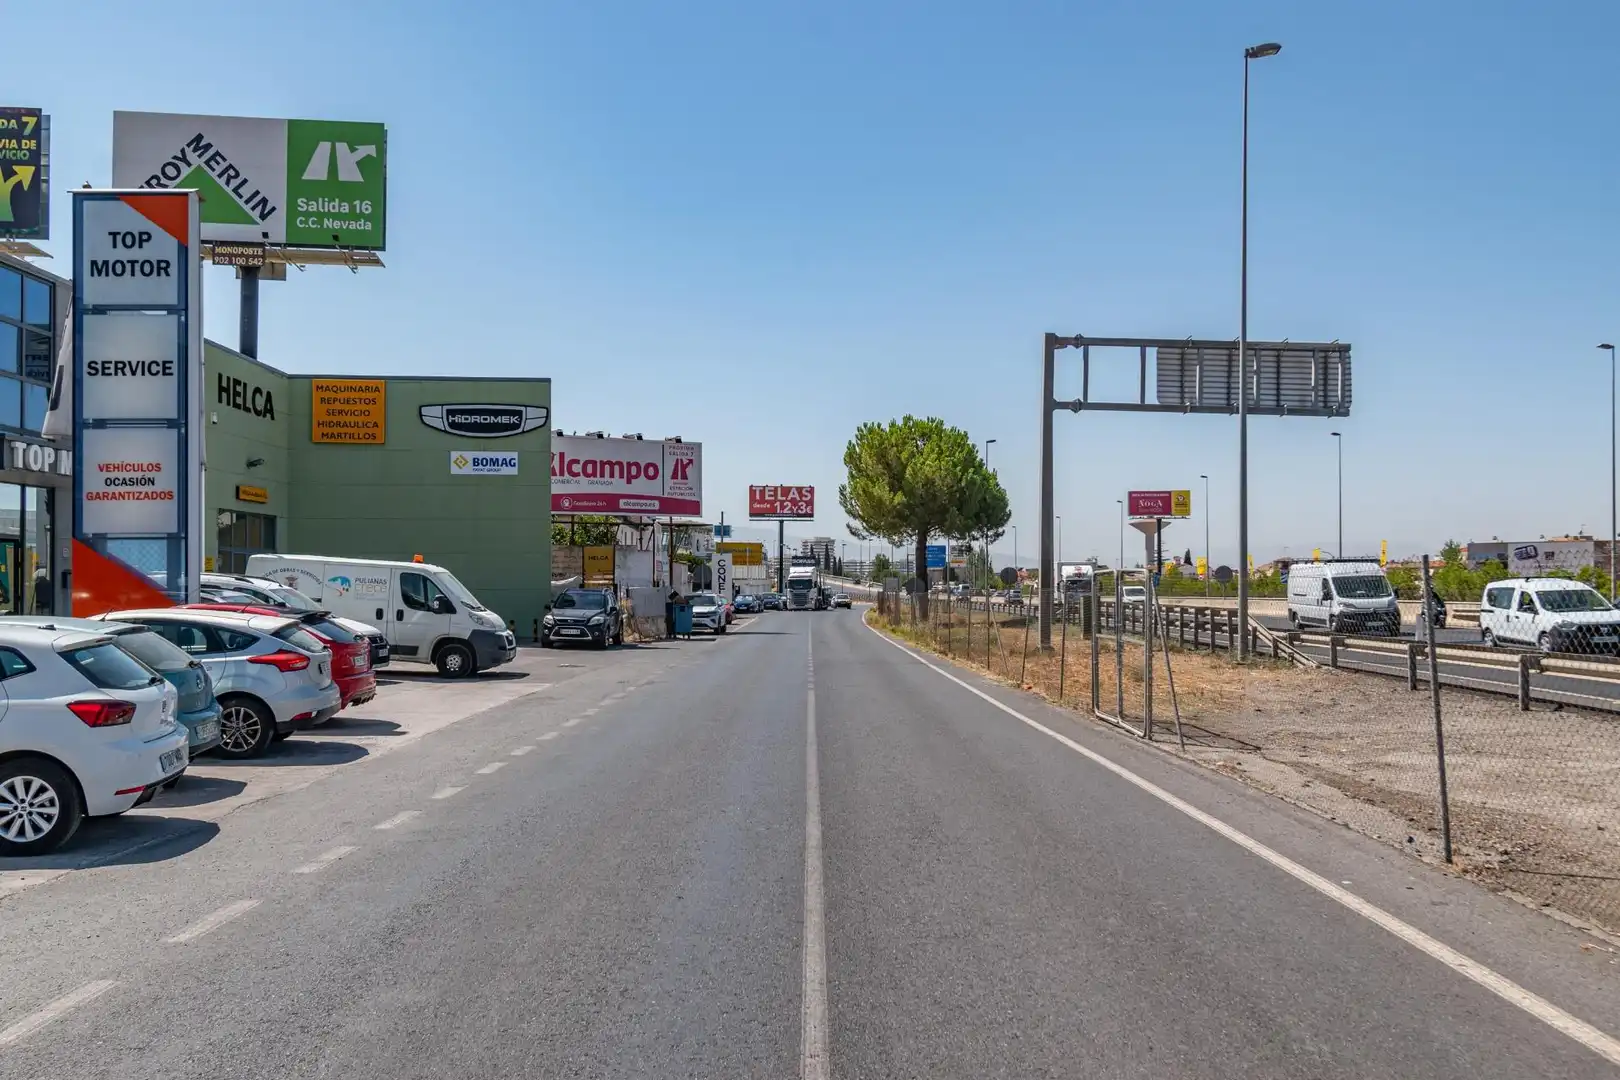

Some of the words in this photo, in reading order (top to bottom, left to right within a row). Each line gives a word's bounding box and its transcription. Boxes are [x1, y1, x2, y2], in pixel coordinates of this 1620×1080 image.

[21, 116, 38, 136] 7
[21, 139, 37, 150] DE
[0, 149, 29, 160] VICIO
[138, 147, 192, 189] ROY
[186, 132, 277, 222] MERLIN
[297, 197, 349, 213] Salida
[353, 200, 372, 214] 16
[296, 217, 320, 228] C.C.
[323, 218, 372, 230] Nevada
[108, 231, 152, 250] TOP
[215, 246, 263, 255] MONOPOSTE
[214, 256, 229, 264] 902
[232, 257, 246, 265] 100
[248, 257, 263, 265] 542
[90, 259, 171, 278] MOTOR
[87, 359, 174, 377] SERVICE
[315, 384, 381, 394] MAQUINARIA
[217, 372, 275, 421] HELCA
[320, 396, 377, 406] REPUESTOS
[326, 408, 371, 417] SERVICIO
[317, 420, 379, 430] HIDRAULICA
[321, 431, 377, 440] MARTILLOS
[10, 441, 55, 471] TOP
[472, 457, 516, 467] BOMAG
[97, 461, 162, 473] VEHÍCULOS
[104, 474, 155, 487] OCASIÓN
[86, 490, 174, 501] GARANTIZADOS
[752, 486, 811, 501] TELAS
[355, 577, 387, 585] PULIANAS
[717, 559, 726, 594] CONE
